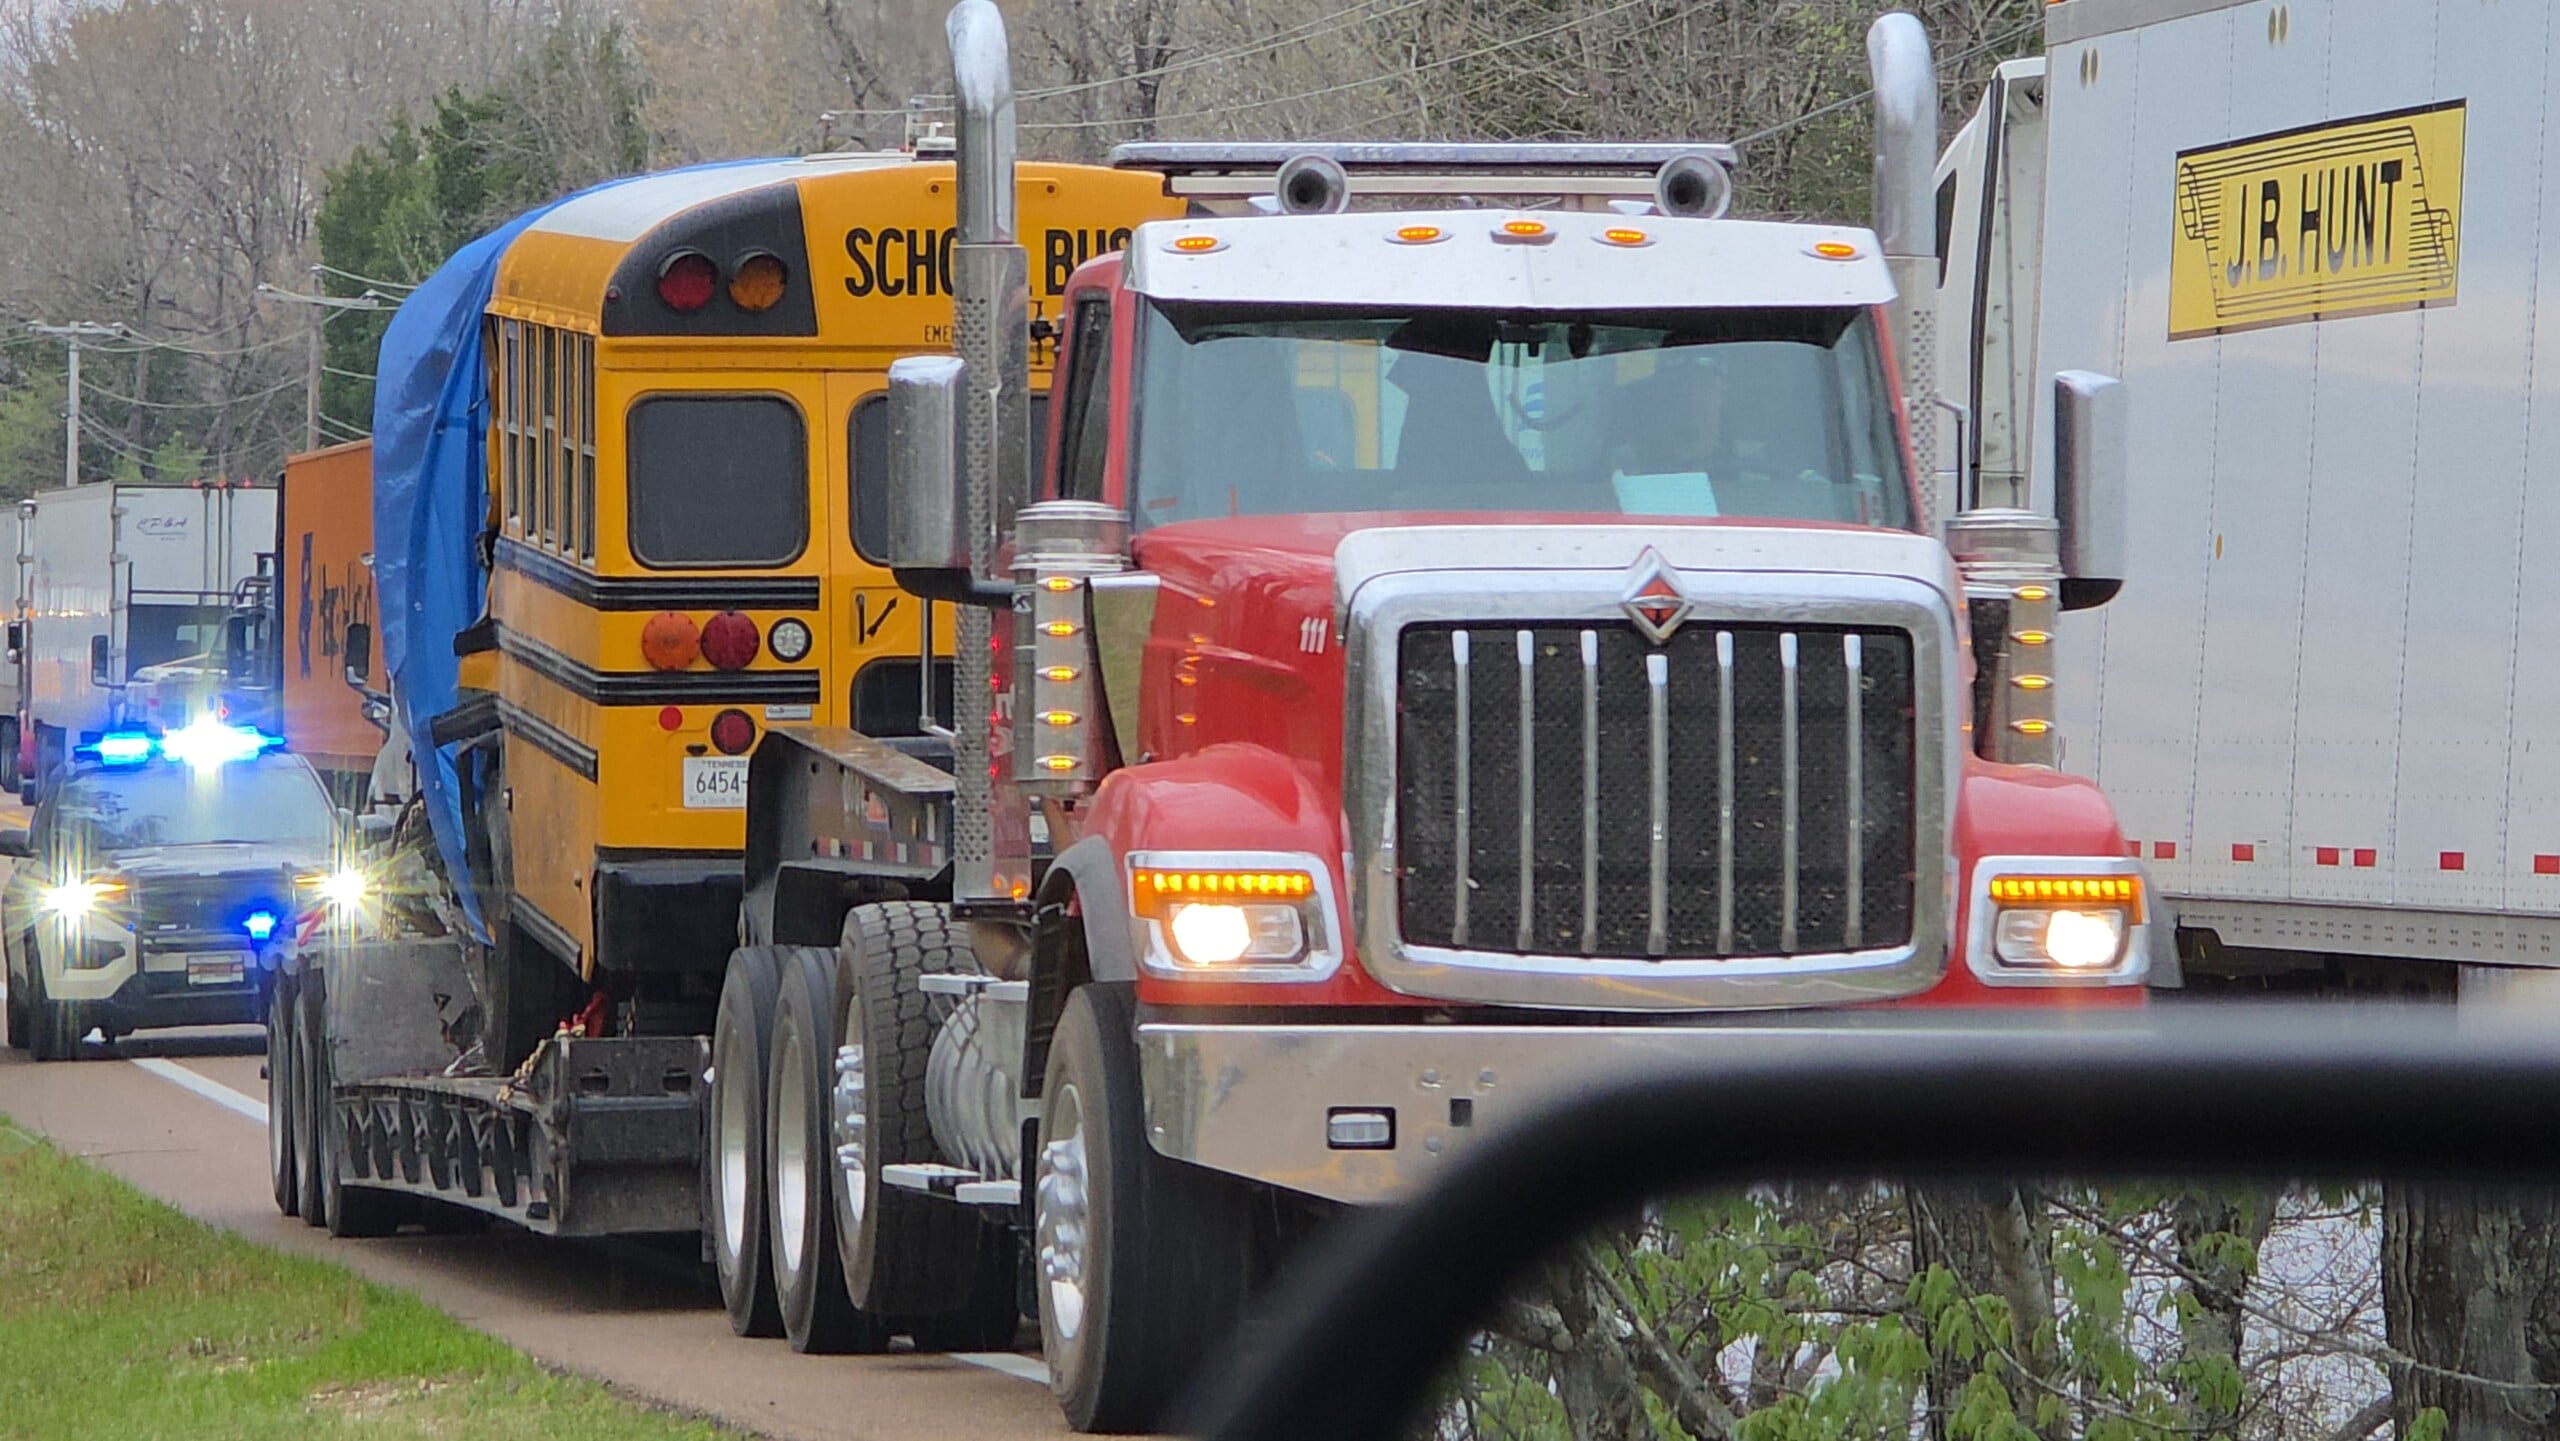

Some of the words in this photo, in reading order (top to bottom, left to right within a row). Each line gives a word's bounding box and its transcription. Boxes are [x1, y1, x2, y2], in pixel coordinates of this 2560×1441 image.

[2226, 179, 2287, 289] J.B.
[2298, 158, 2403, 275] HUNT
[844, 227, 1032, 297] SCHO
[1300, 616, 1329, 654] 111
[707, 761, 748, 769] TENNESS
